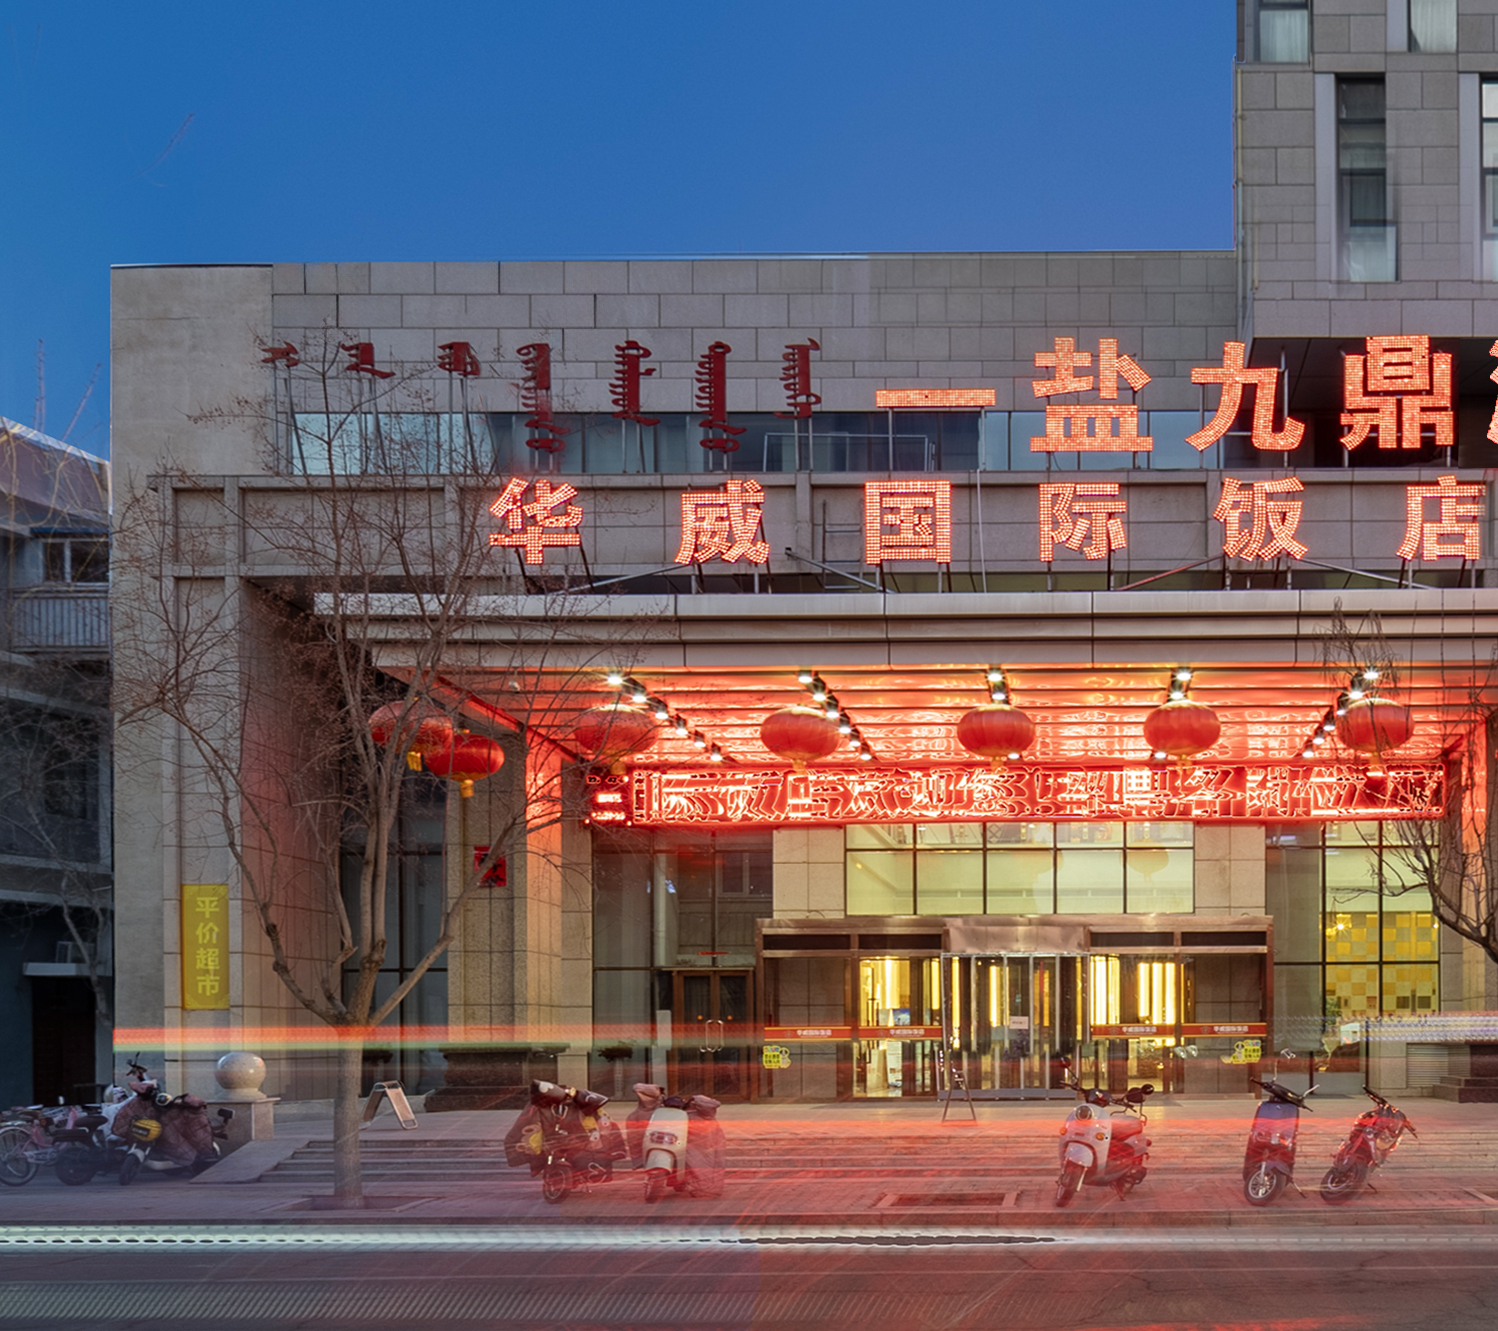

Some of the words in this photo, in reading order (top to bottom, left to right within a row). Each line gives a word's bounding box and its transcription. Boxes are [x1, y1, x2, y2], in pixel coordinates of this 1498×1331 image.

[487, 473, 1482, 566] 华威国际饭店
[194, 896, 221, 997] 平价超市
